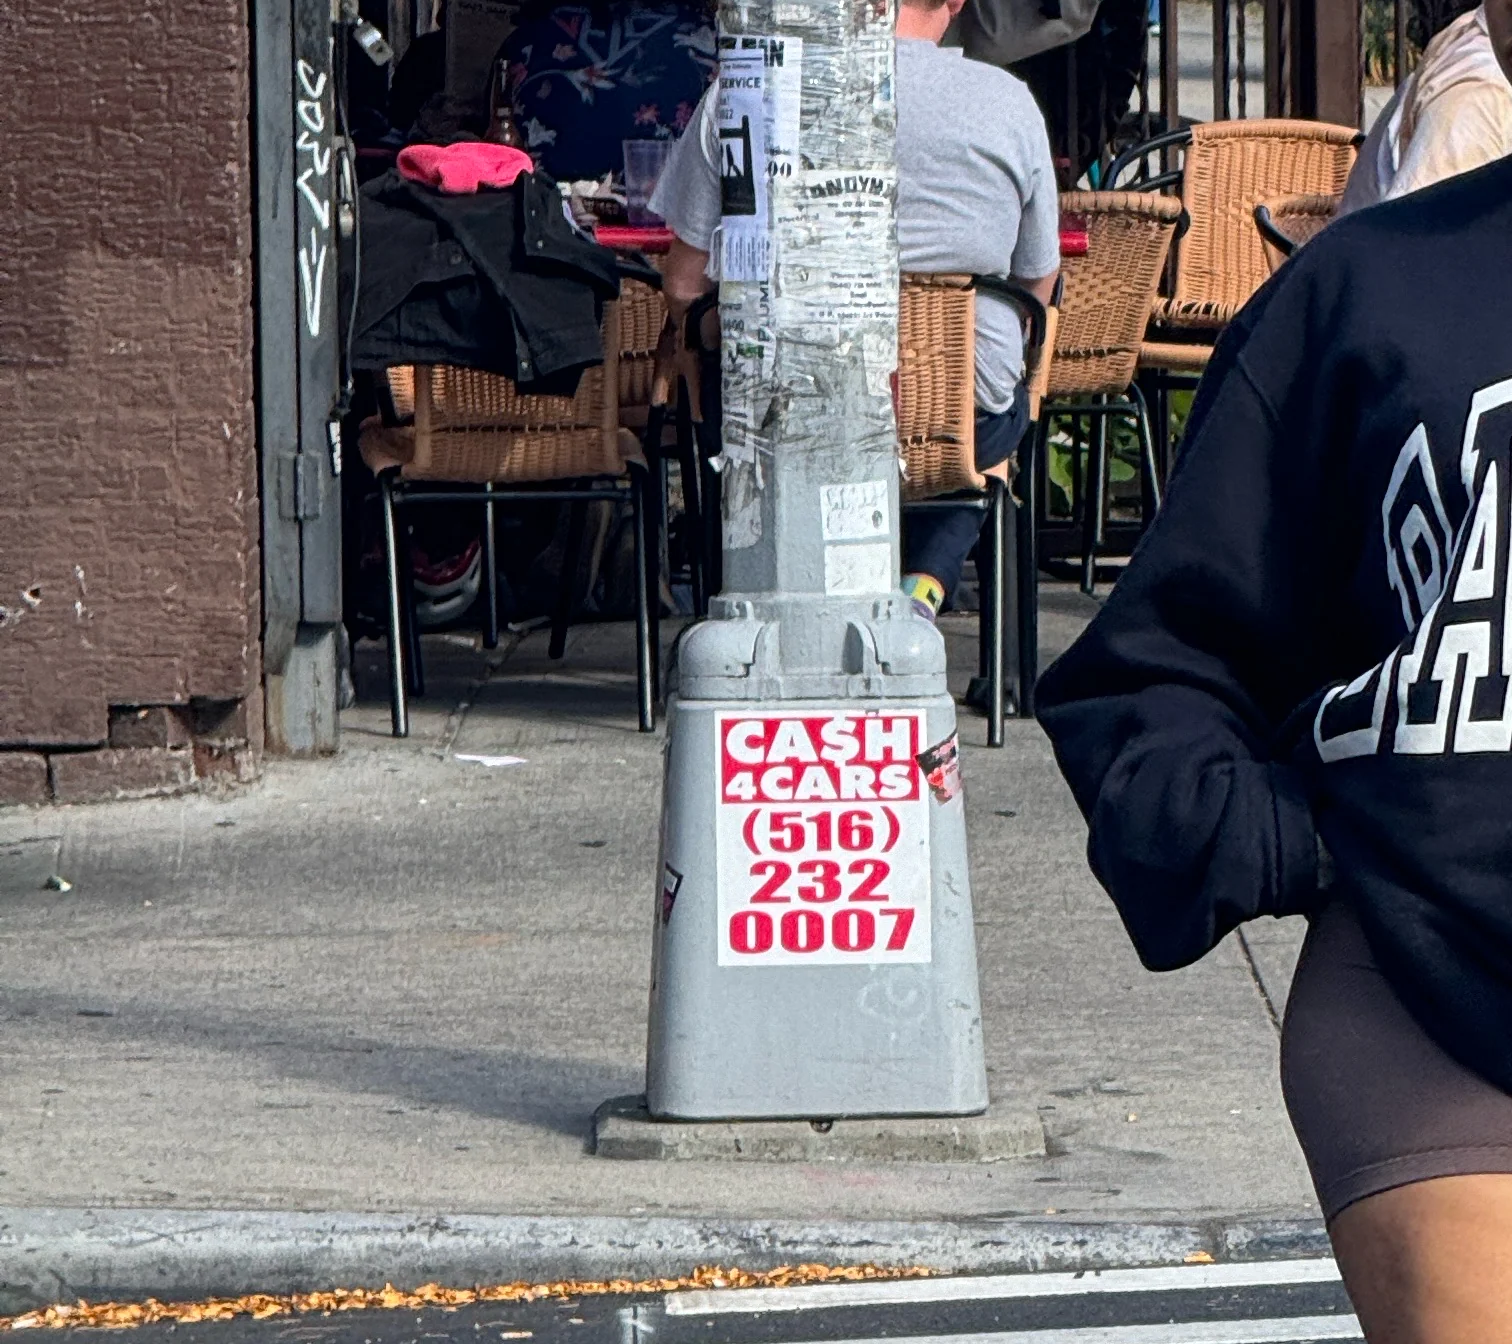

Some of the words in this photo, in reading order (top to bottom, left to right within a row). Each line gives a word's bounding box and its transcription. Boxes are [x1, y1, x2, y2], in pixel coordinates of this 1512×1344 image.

[720, 77, 762, 89] ERVICE
[742, 806, 901, 855] (516)
[750, 859, 891, 904] 232
[729, 908, 916, 954] 0007
